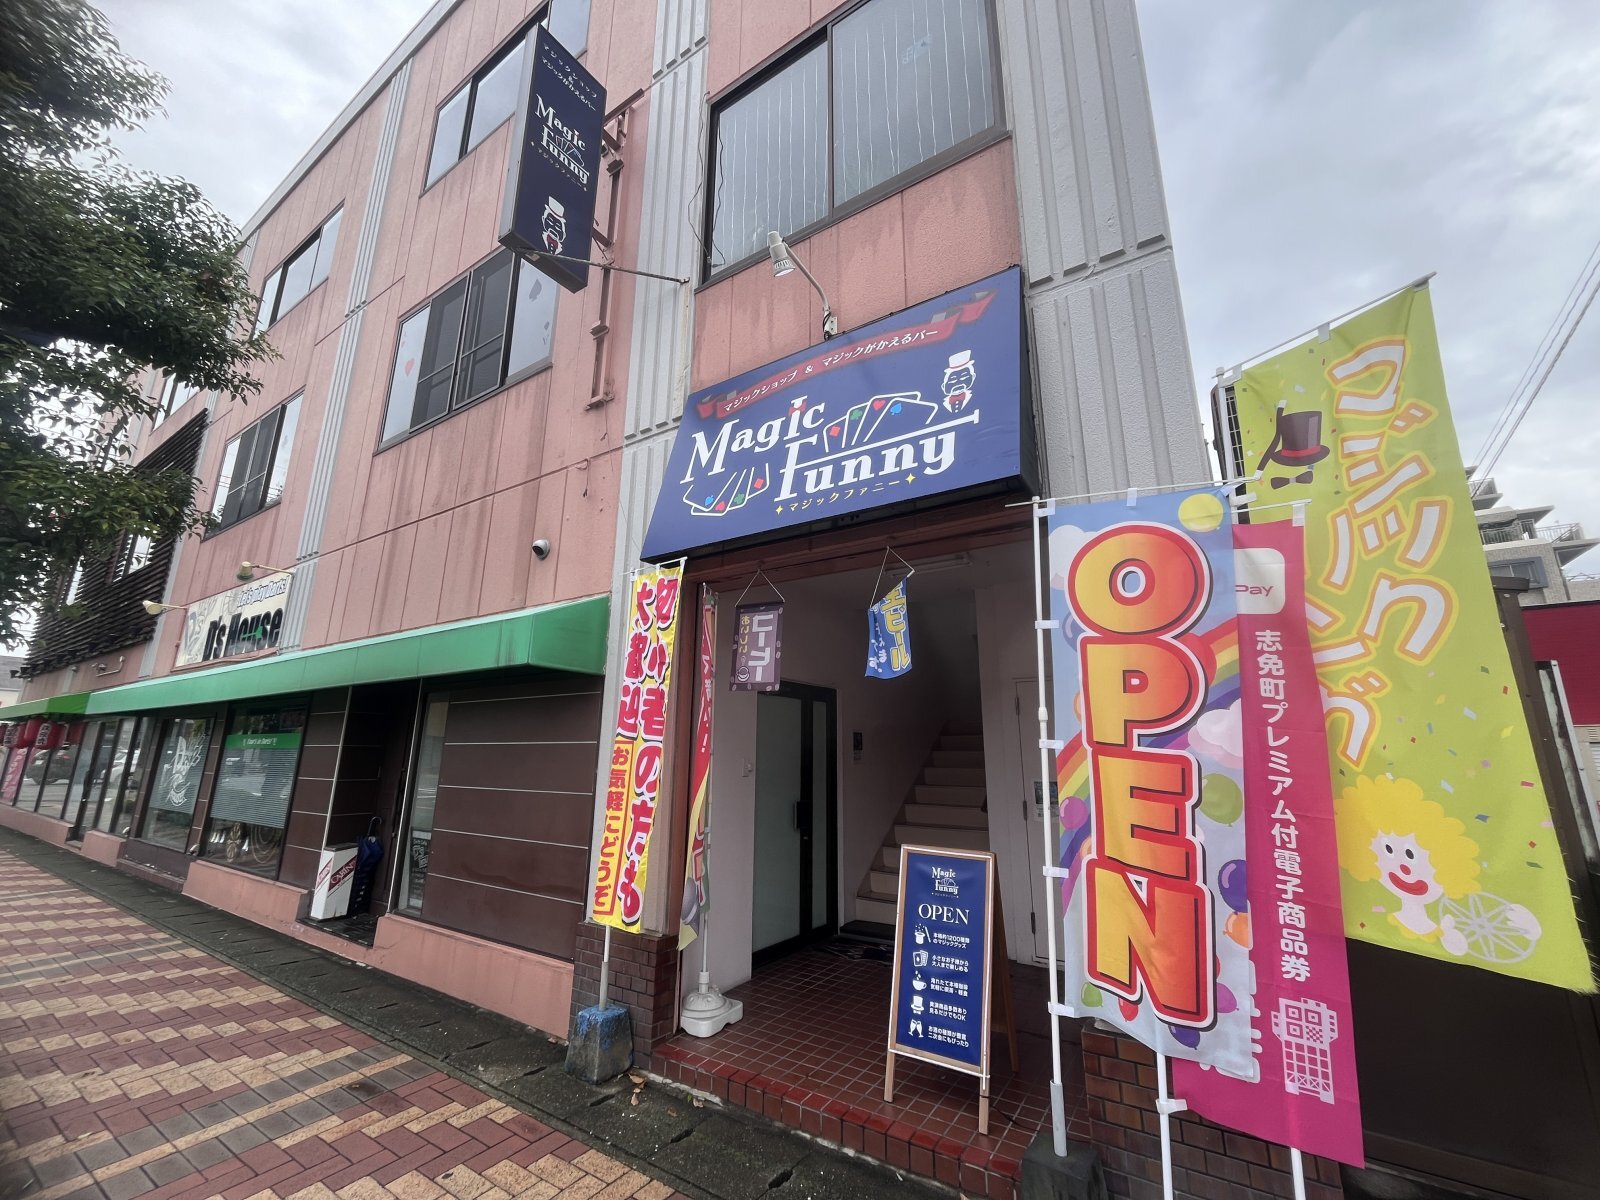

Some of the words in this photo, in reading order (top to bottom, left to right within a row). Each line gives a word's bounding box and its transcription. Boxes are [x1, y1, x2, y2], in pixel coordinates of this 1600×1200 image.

[535, 93, 586, 151] Magic
[541, 124, 590, 184] Funny
[723, 370, 798, 412] マジックショップ
[805, 365, 814, 375] &
[822, 327, 939, 368] マジックがかえるバー
[680, 395, 826, 485] Magic
[774, 410, 979, 504] Funny
[788, 480, 900, 512] マジックファニー
[223, 608, 284, 658] House
[1069, 522, 1214, 1029] OPEN
[1255, 629, 1311, 983] 志免町プレミアム付電子商品券
[932, 866, 957, 878] Magic
[935, 879, 959, 895] Funny
[918, 903, 970, 925] OPEN
